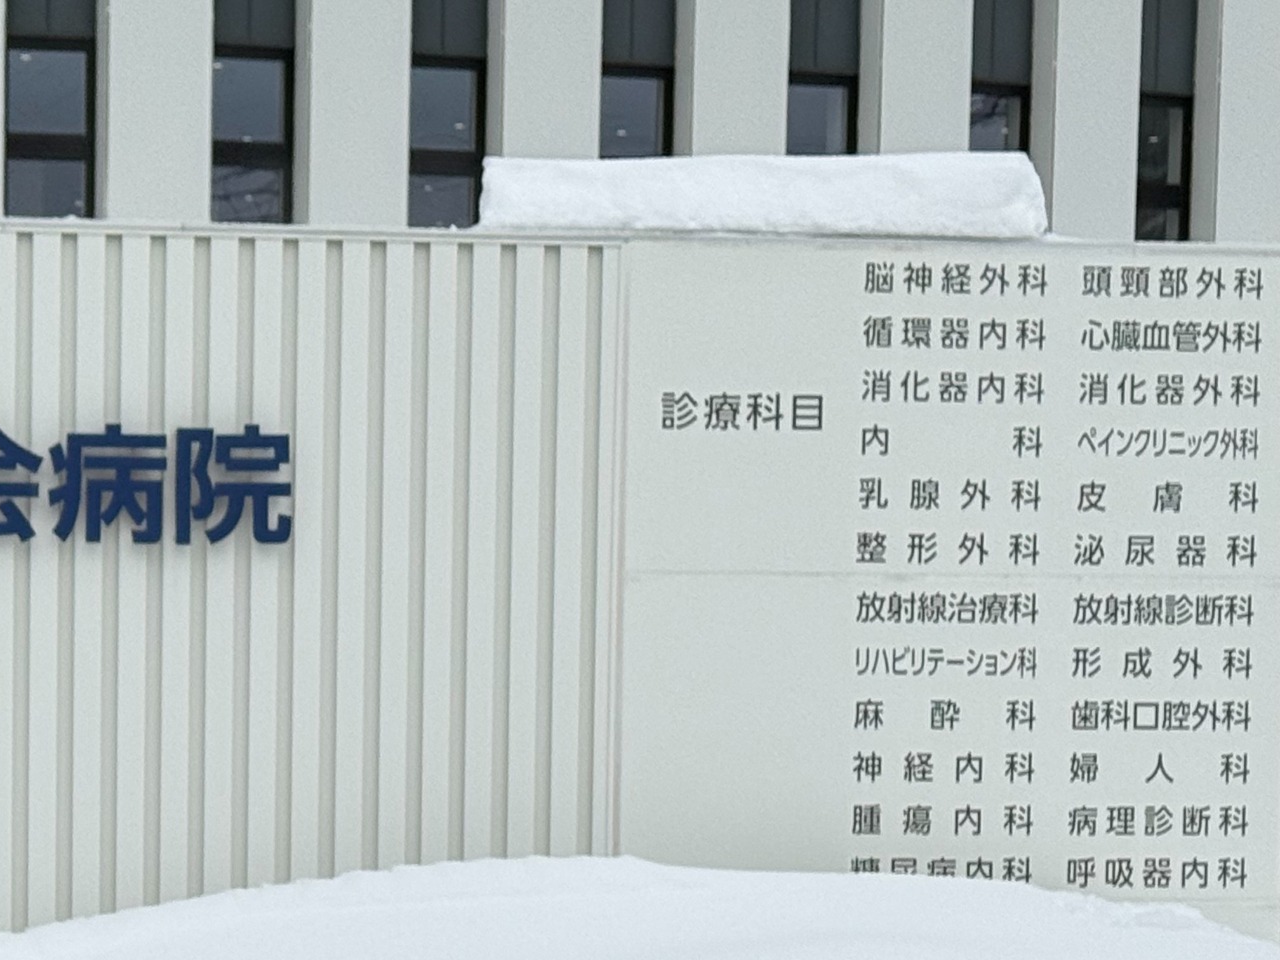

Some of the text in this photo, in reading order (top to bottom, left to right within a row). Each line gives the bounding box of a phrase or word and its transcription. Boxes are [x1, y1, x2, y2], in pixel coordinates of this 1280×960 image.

[865, 262, 1047, 296] 脳神経外科
[1082, 266, 1263, 299] 頭頸部外科
[864, 316, 1045, 350] 循環器内科
[1081, 320, 1261, 353] 心臓血管外科
[862, 370, 1043, 404] 消化器内科
[1080, 373, 1260, 406] 消化器外科
[662, 392, 823, 430] 診療科目
[1078, 427, 1258, 459] ペインクリニック外科
[860, 478, 1040, 511] 乳腺外科
[856, 532, 1039, 565] 整形外科
[1074, 535, 1256, 567] 泌尿器科
[857, 592, 1038, 624] 放射線治療科
[1073, 594, 1253, 626] 放射線診断科
[856, 647, 1036, 678] リハビリテーション科
[1073, 647, 1252, 679] 形成外科
[1072, 700, 1251, 731] 歯科口腔外科
[853, 752, 1034, 783] 神経内科
[852, 805, 1033, 835] 腫瘍内科
[1069, 806, 1248, 836] 病理診断科
[1067, 857, 1247, 888] 呼吸器内科
